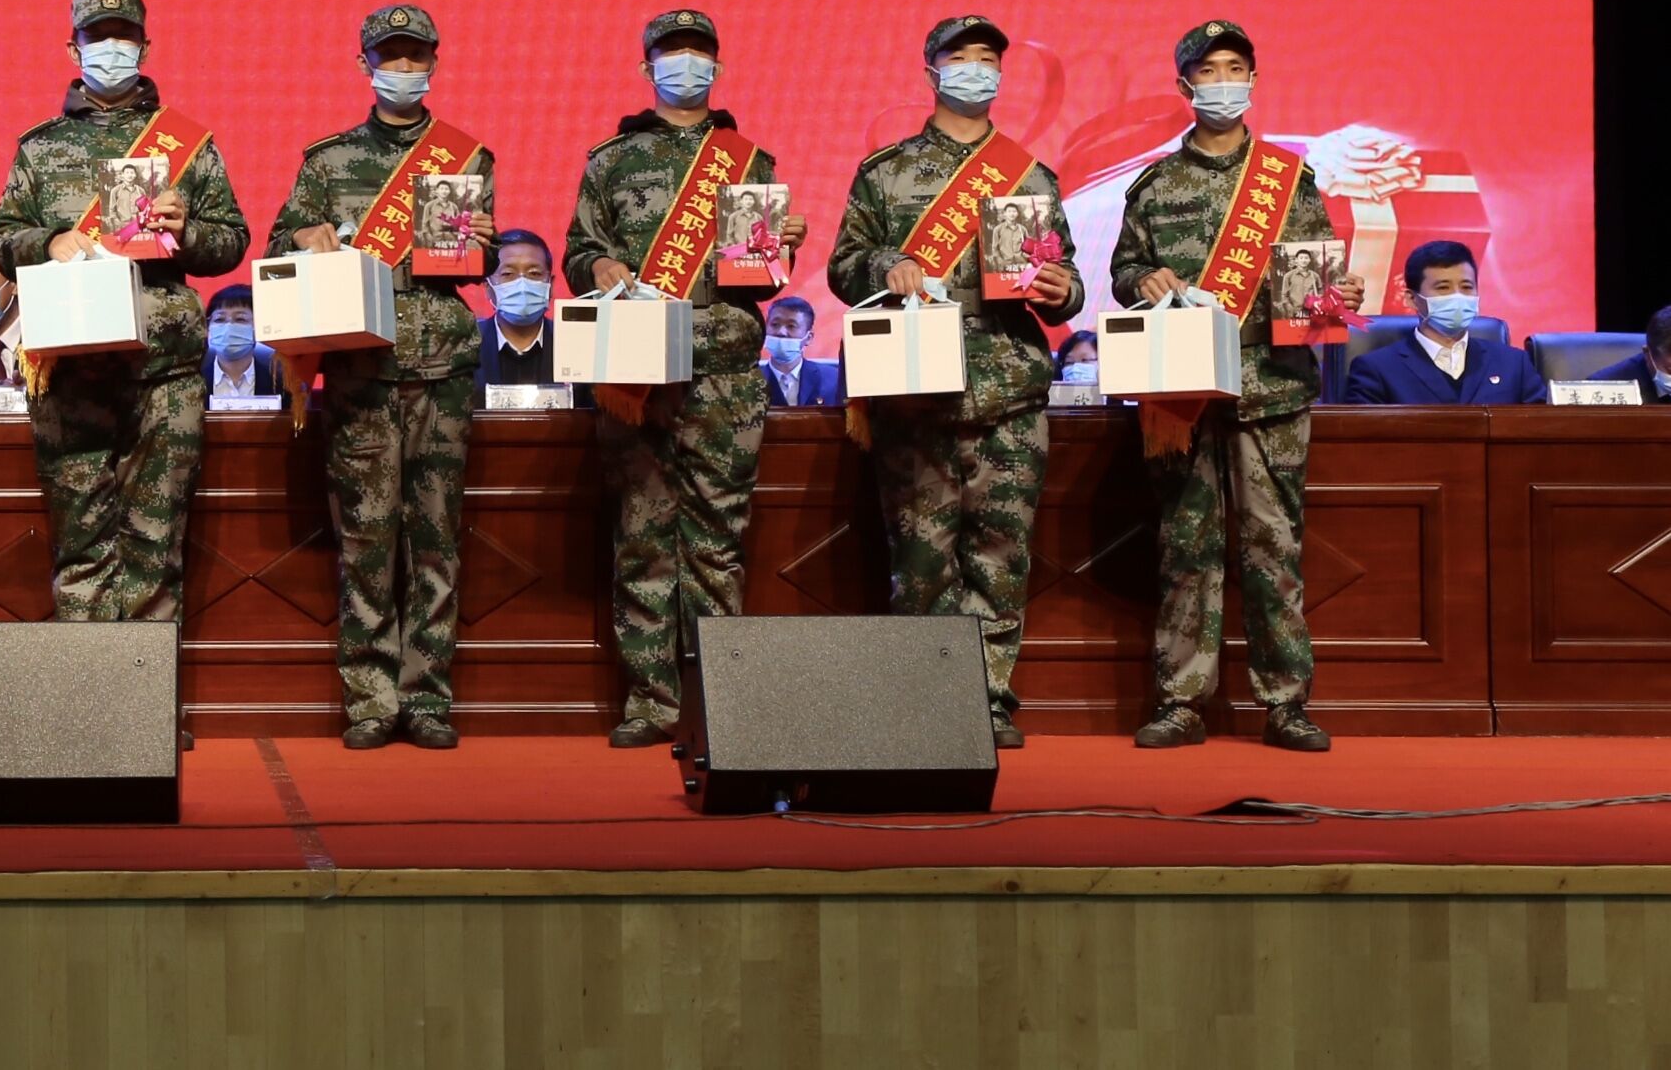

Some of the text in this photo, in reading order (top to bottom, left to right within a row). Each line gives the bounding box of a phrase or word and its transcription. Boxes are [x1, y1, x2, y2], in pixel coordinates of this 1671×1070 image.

[648, 145, 737, 300] 吉林铁道职业技术
[913, 162, 1009, 276] 吉林铁道职业
[1212, 153, 1289, 308] 吉林铁道职业技术
